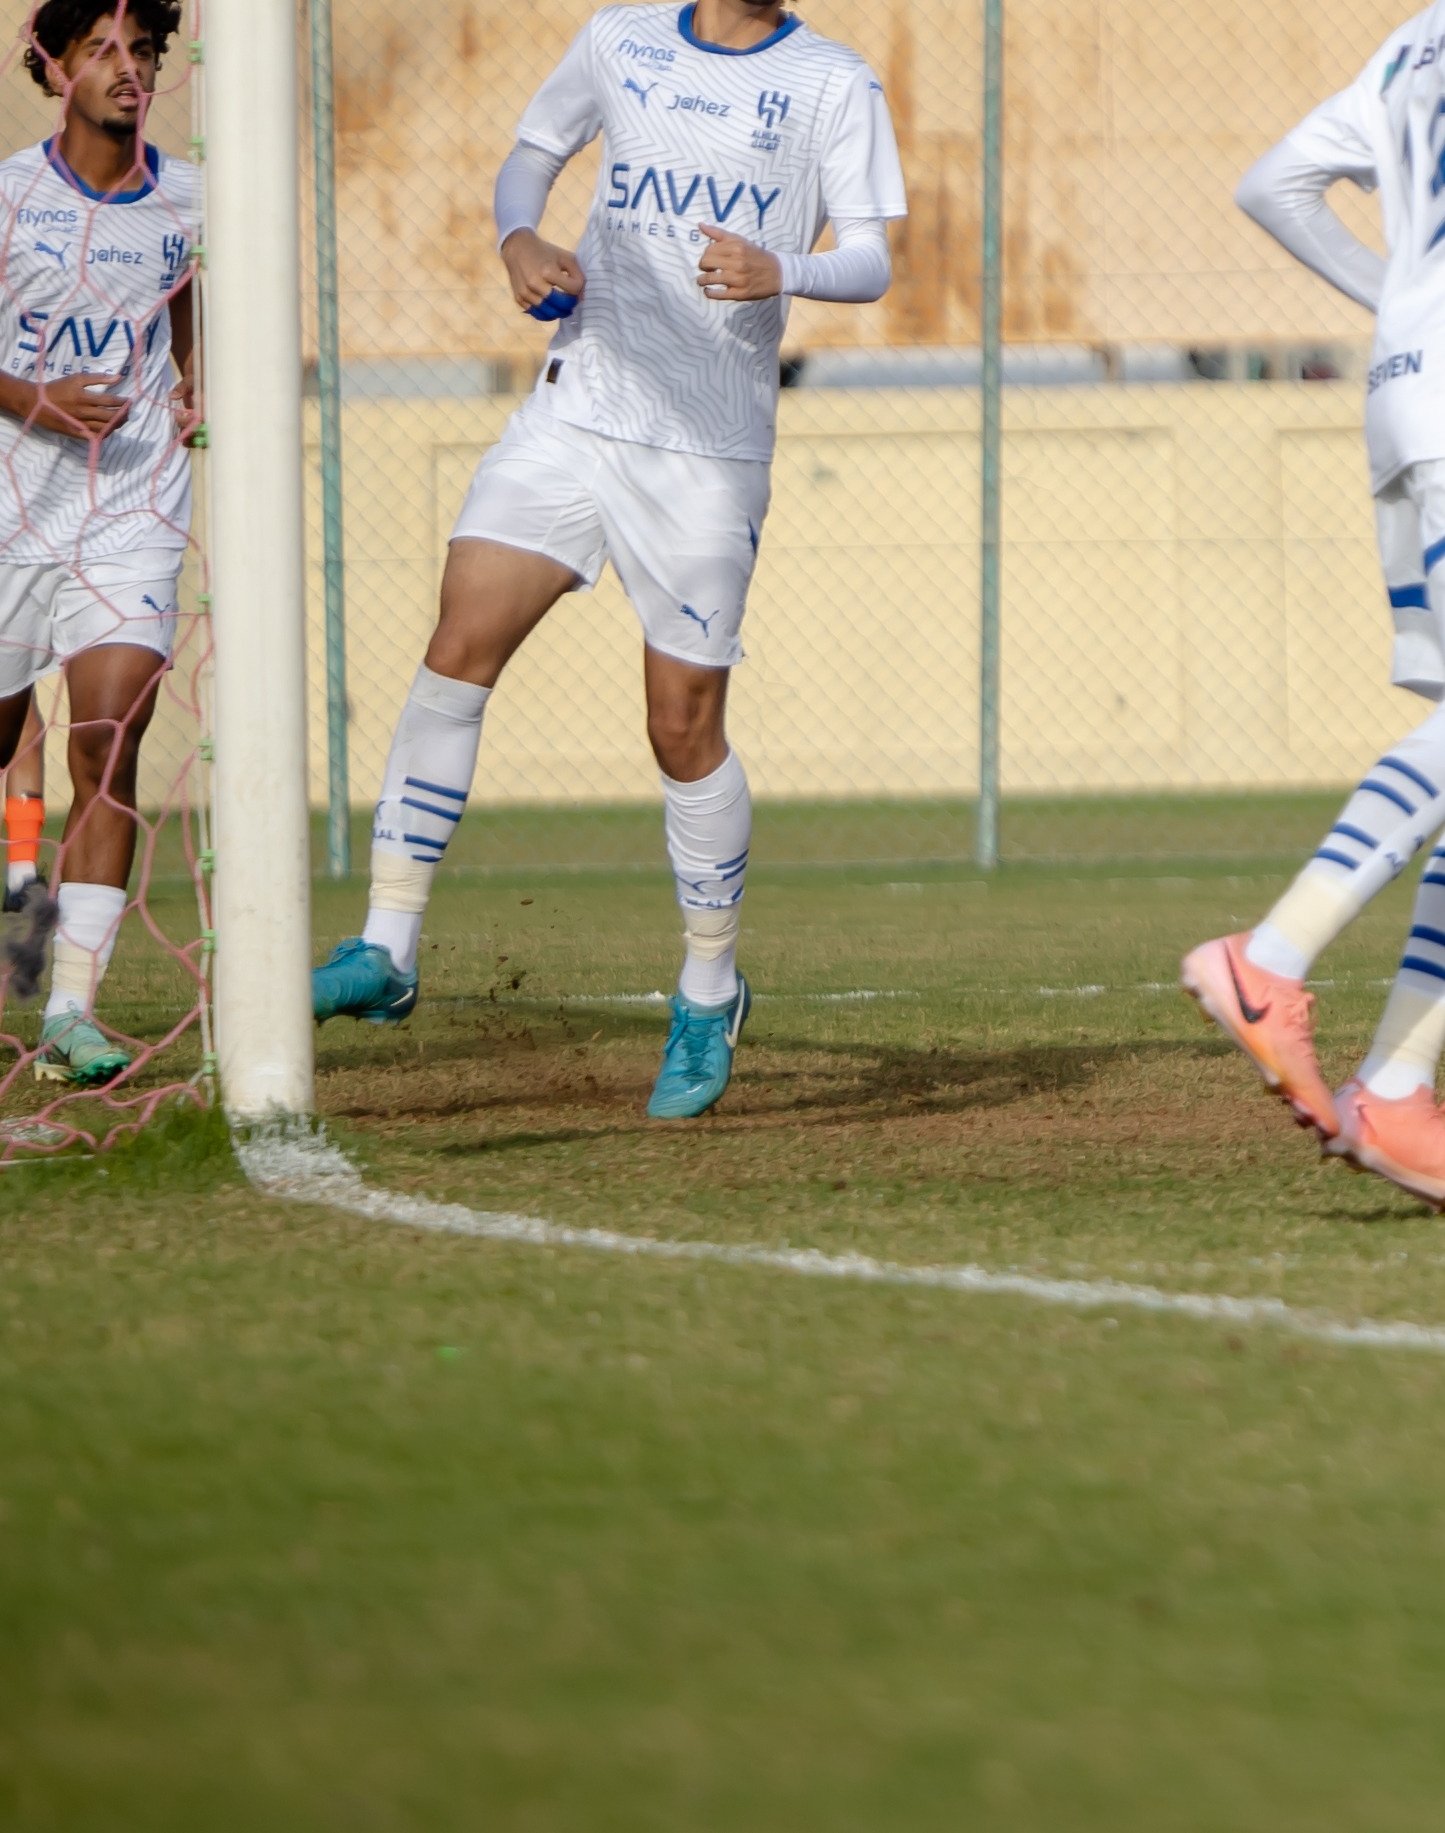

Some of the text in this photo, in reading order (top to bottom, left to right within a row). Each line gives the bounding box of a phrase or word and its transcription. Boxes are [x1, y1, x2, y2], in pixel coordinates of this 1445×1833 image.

[617, 38, 677, 62] flynas
[667, 94, 731, 117] jahez
[607, 162, 782, 230] SAVVY
[17, 208, 78, 226] flynas
[85, 246, 144, 265] jahez
